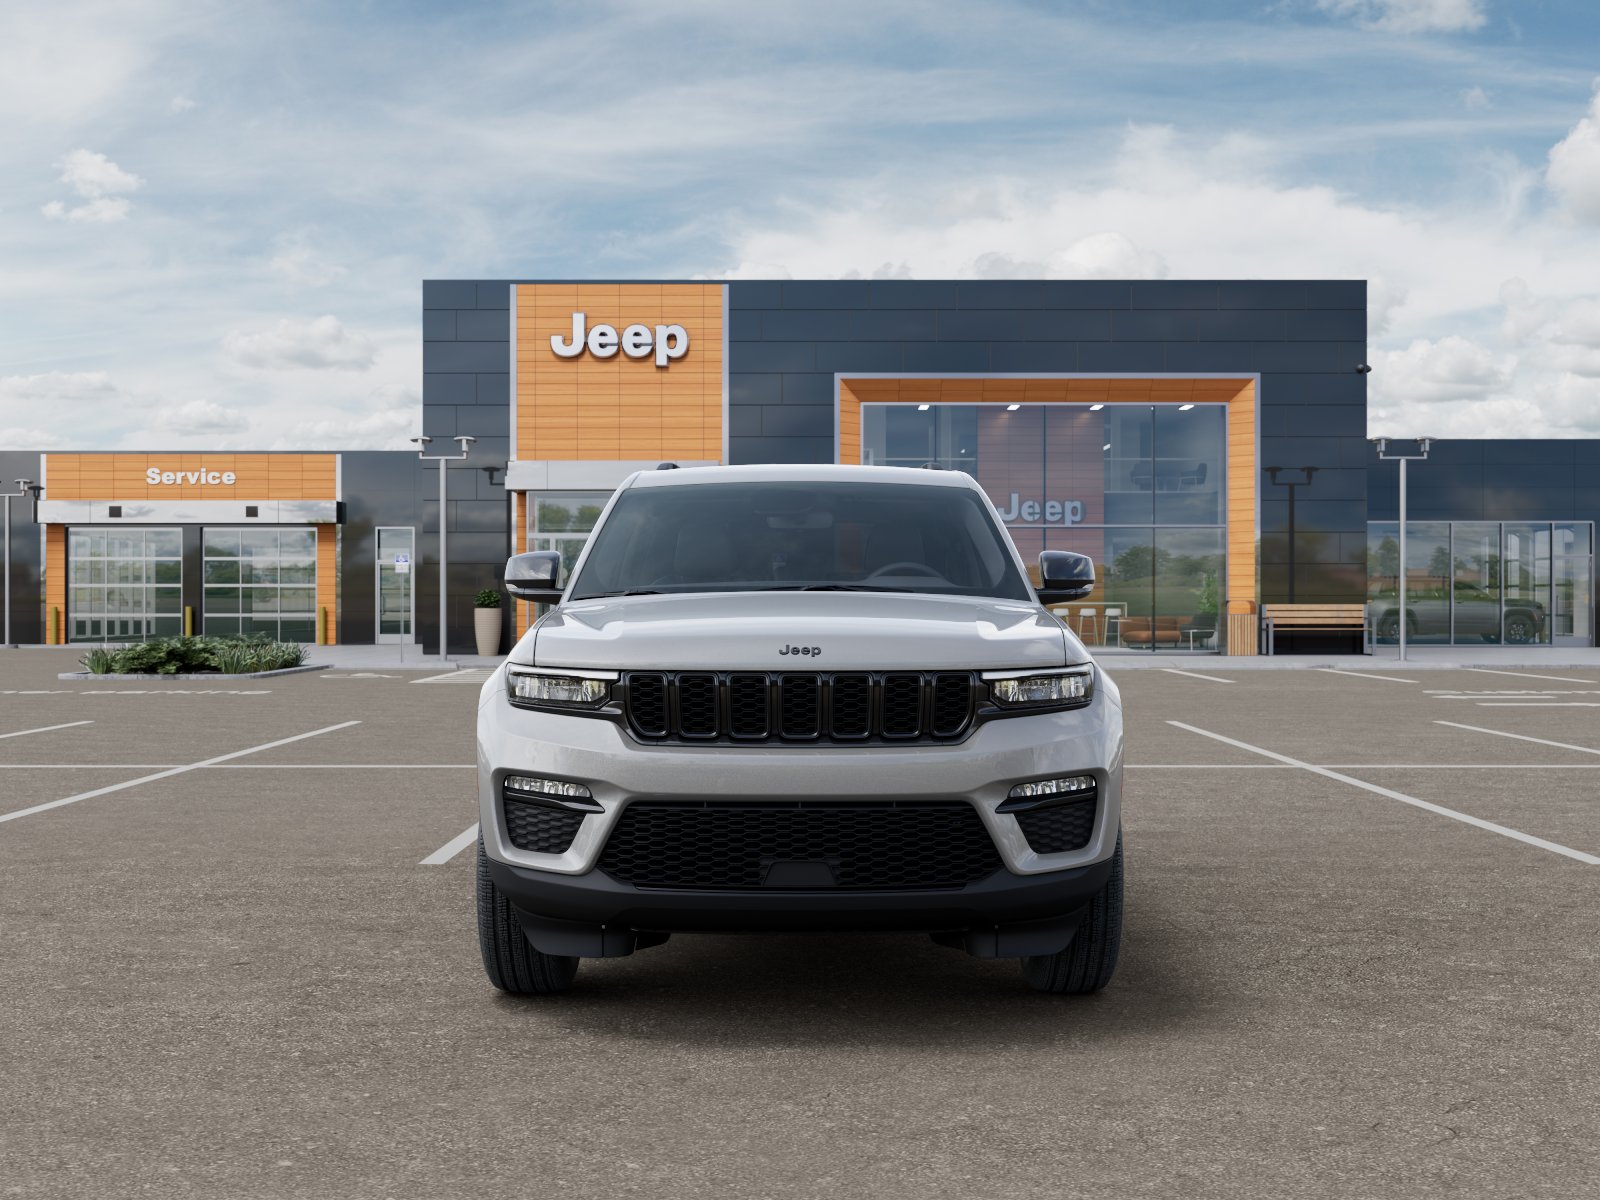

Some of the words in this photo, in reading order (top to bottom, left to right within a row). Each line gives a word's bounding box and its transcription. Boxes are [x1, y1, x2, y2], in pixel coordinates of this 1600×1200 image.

[550, 311, 689, 367] Jeep
[146, 467, 236, 485] Service
[997, 493, 1082, 526] Jeep
[778, 644, 822, 658] Jeep
